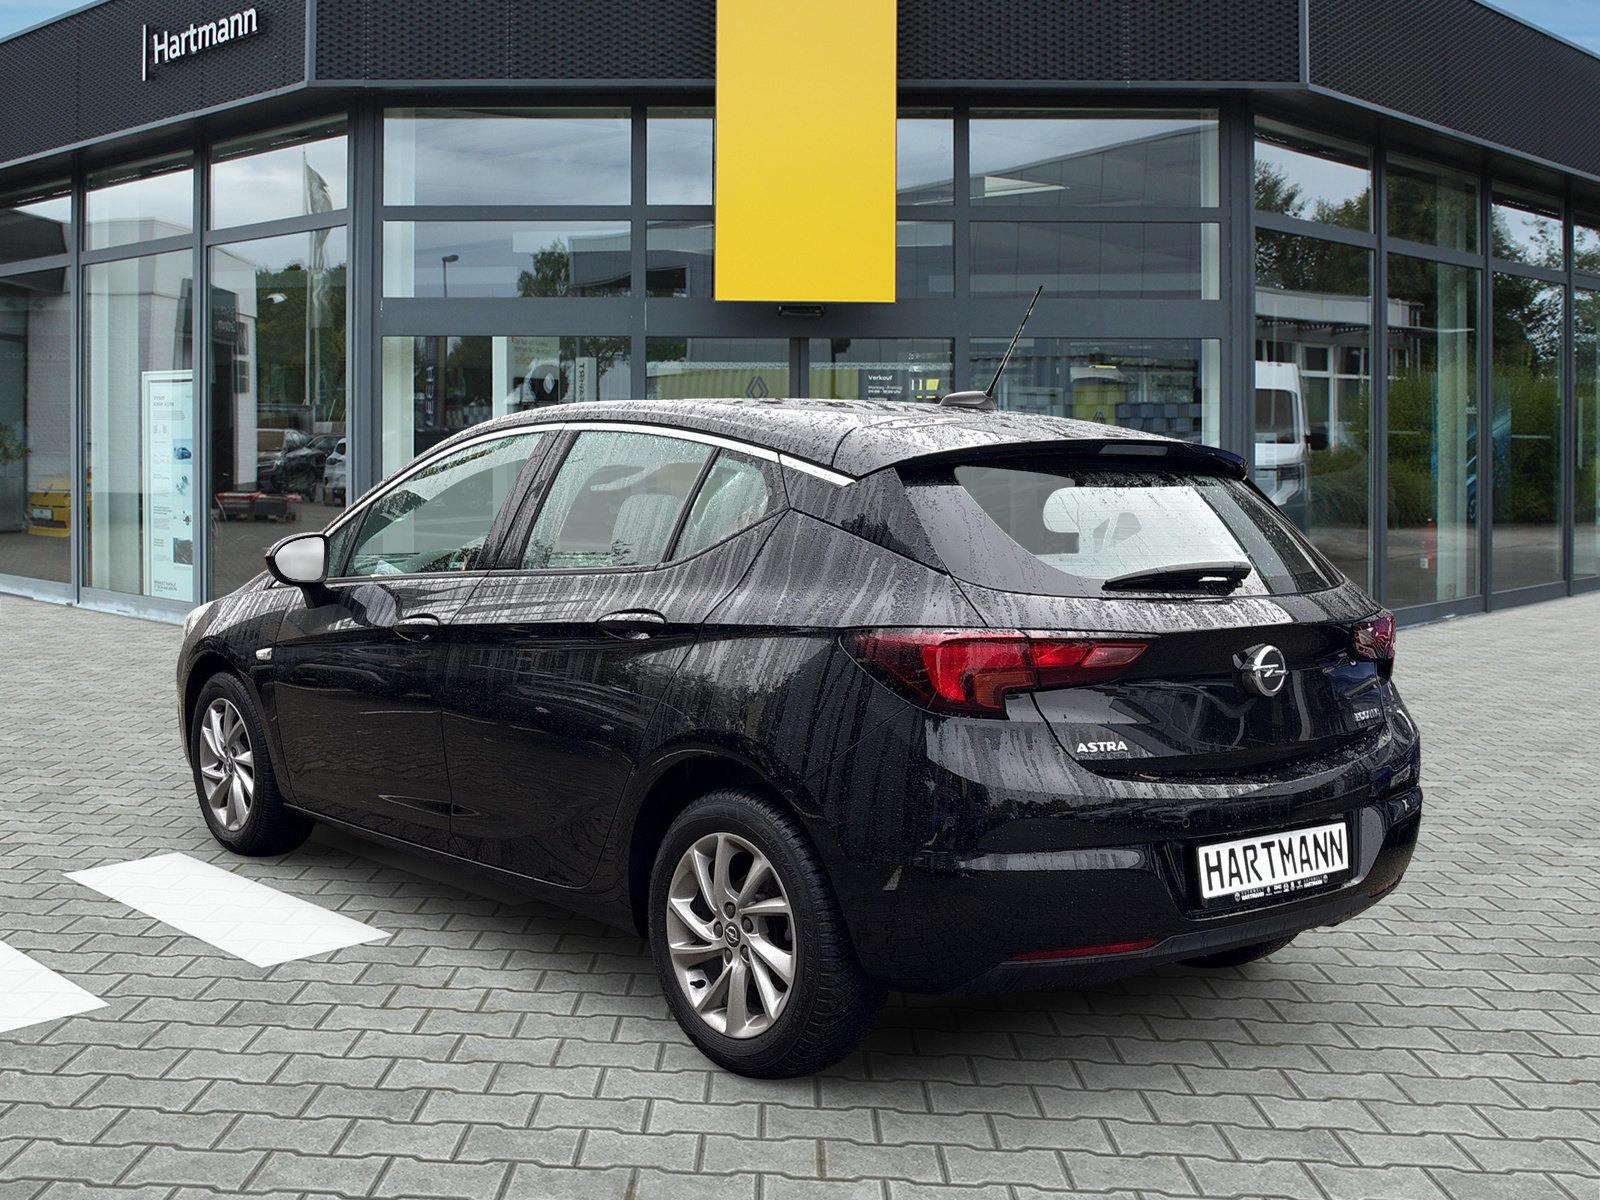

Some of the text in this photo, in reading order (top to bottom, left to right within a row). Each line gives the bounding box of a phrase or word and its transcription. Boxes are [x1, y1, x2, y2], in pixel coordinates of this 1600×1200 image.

[153, 8, 258, 64] Hartmann
[1076, 741, 1128, 753] ASTRA
[1204, 828, 1344, 891] HARTMANN
